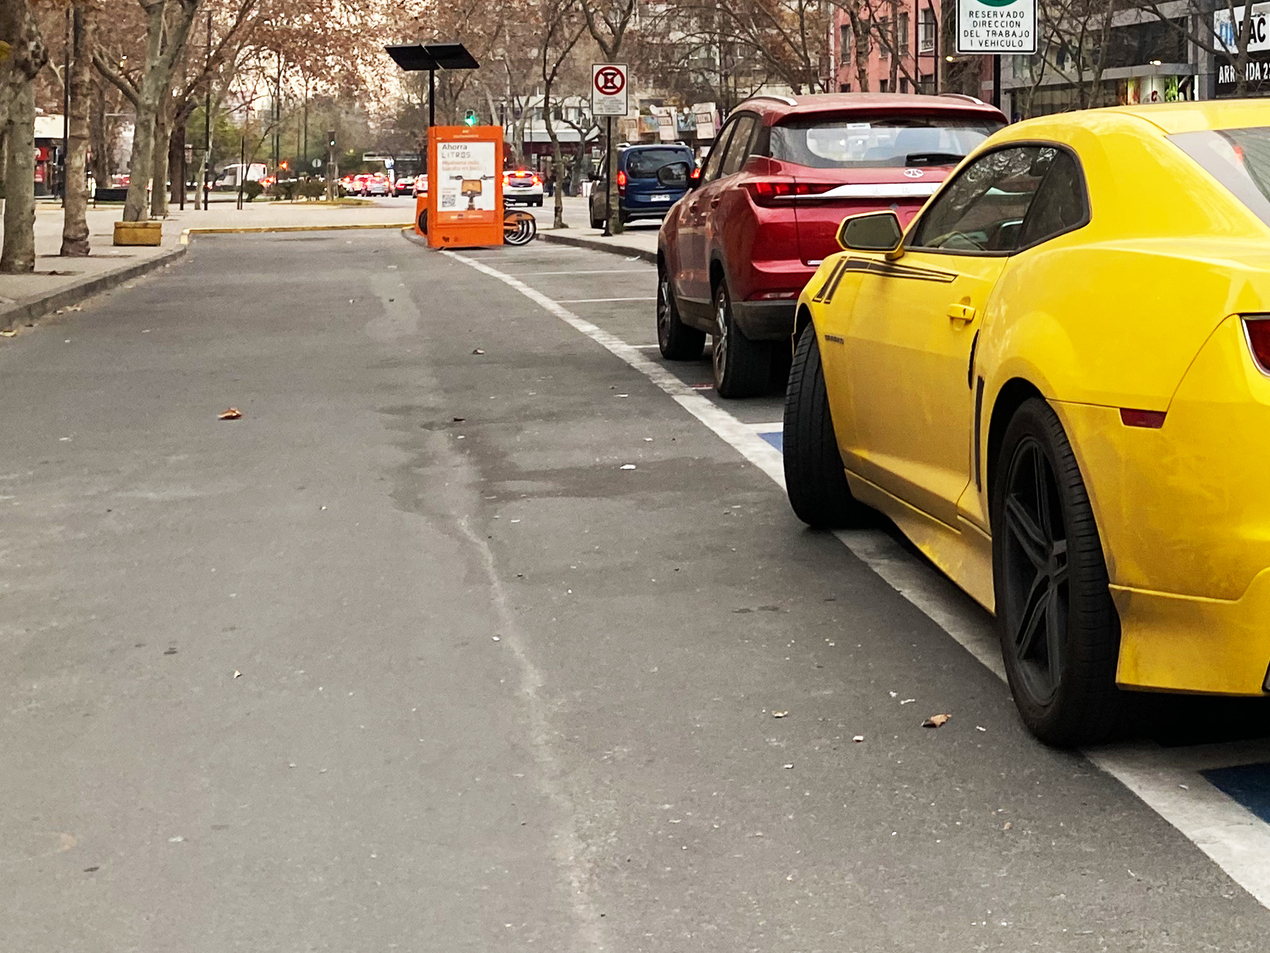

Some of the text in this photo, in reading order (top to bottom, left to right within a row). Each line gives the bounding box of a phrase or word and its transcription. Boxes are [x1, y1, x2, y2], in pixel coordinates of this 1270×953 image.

[968, 10, 1025, 19] RESERVADO
[972, 20, 1021, 28] DIRECCION
[963, 29, 1030, 38] DEL TRABAJO
[978, 39, 1024, 48] VEHICULO
[441, 151, 471, 159] LITROS
